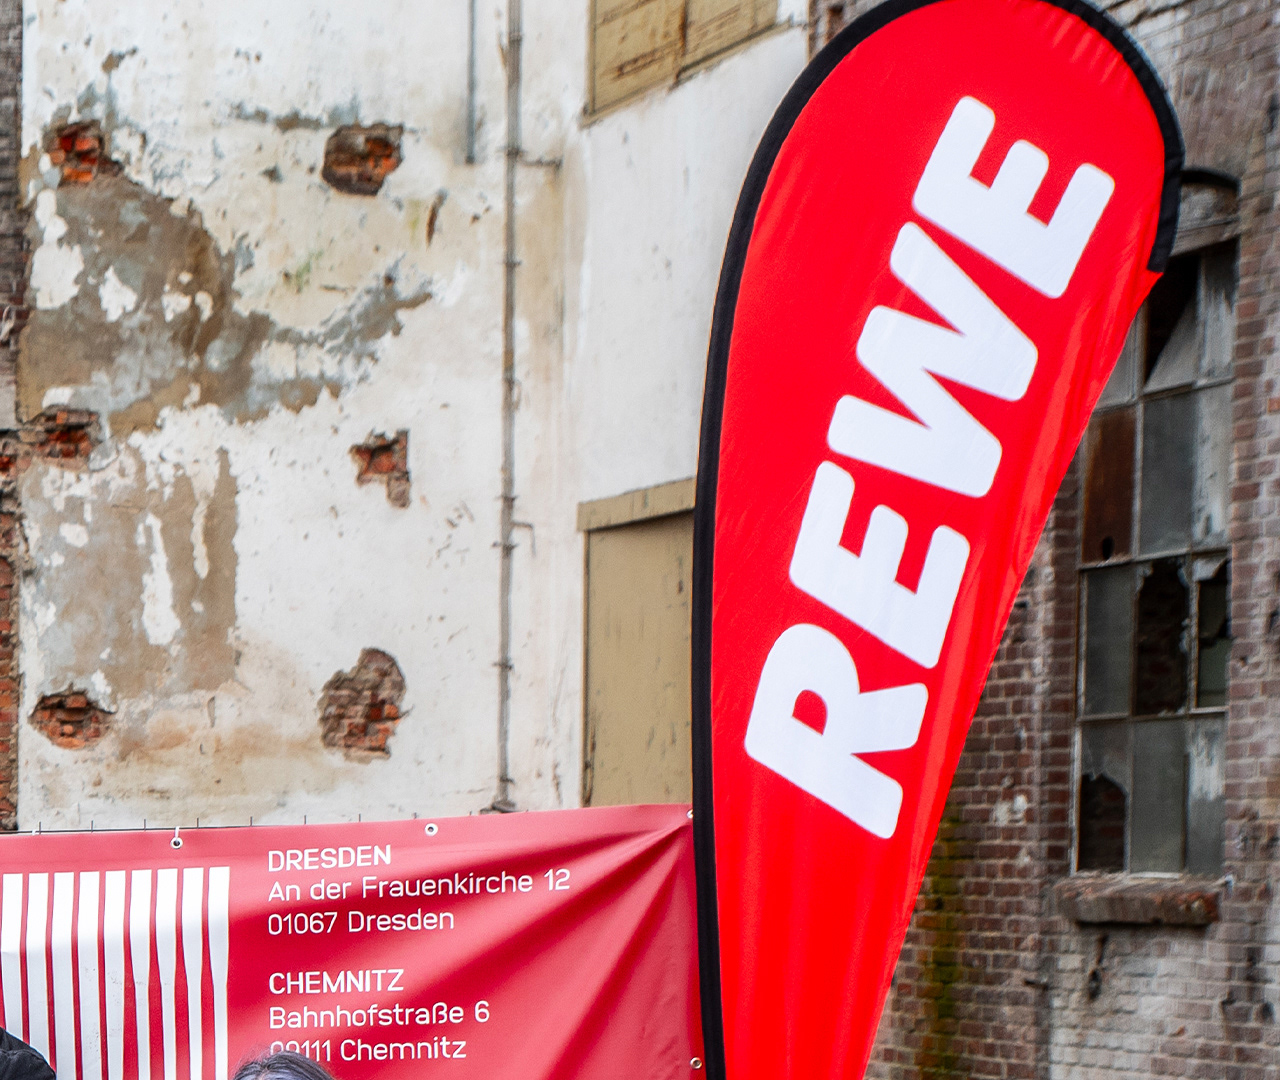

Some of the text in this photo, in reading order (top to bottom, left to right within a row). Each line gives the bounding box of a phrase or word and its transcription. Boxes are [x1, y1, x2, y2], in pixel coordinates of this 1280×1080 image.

[744, 95, 1115, 839] REWE
[268, 844, 392, 872] DRESDEN
[268, 868, 571, 902] An der Frauenkirche 12
[268, 908, 455, 935] 01067 Dresden
[269, 968, 405, 995] CHEMNITZ
[269, 1000, 490, 1029] Bahnhofstraße 6
[340, 1036, 468, 1062] Chemnitz
